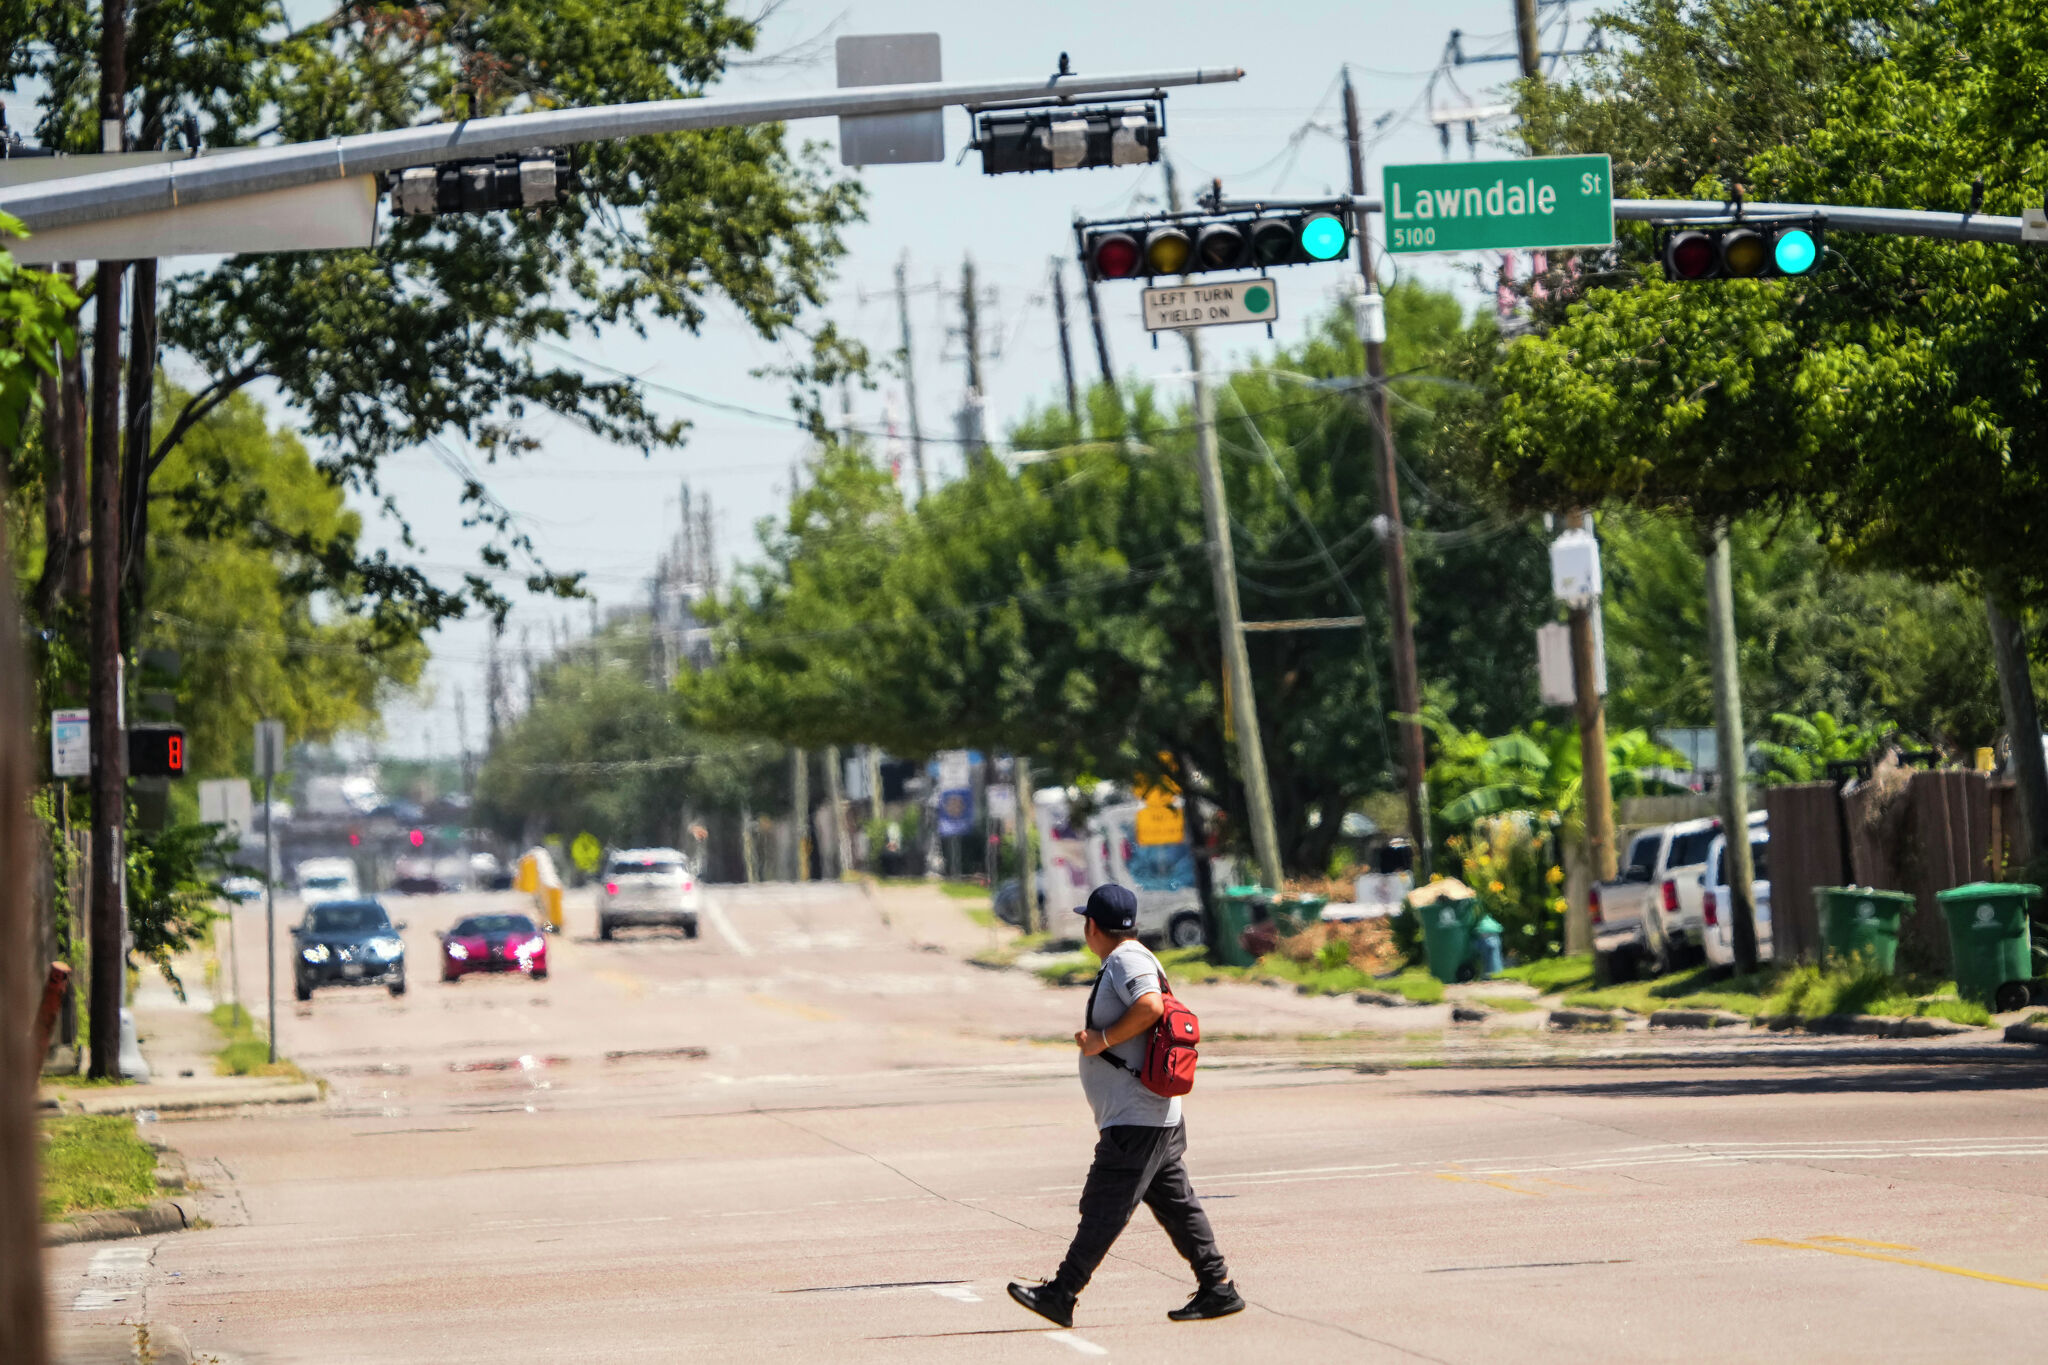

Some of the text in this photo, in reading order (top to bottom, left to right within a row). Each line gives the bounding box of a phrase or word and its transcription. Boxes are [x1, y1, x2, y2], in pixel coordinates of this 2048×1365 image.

[1392, 172, 1602, 220] Lawndale St
[1393, 227, 1436, 247] 5100
[1151, 288, 1234, 306] LEFT TURN
[1160, 306, 1230, 322] YIELD ON
[168, 735, 182, 770] 8
